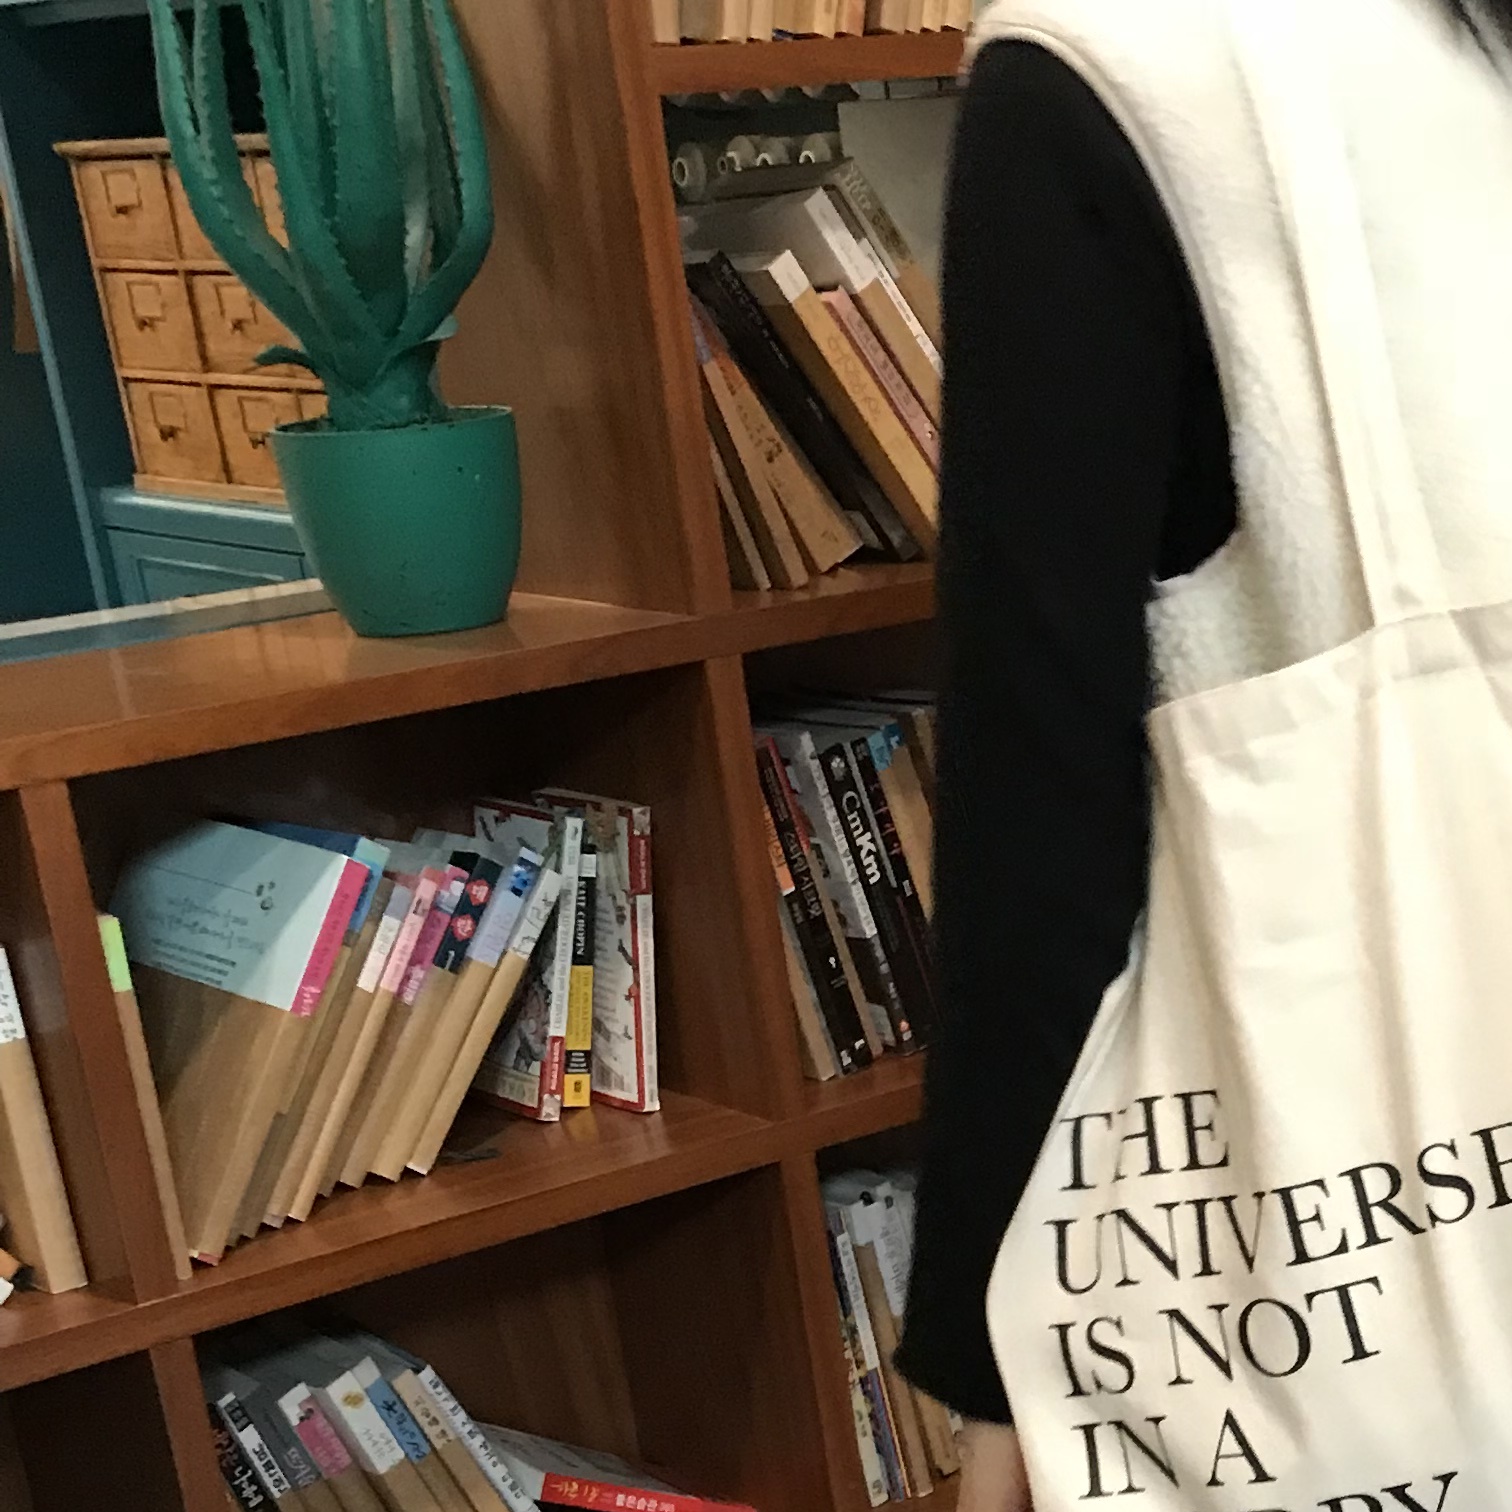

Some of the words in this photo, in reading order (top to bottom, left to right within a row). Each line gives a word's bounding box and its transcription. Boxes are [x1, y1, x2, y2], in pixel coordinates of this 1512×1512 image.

[842, 790, 881, 885] CmKm
[1058, 1089, 1231, 1192] THE
[1048, 1315, 1136, 1398] IS
[1158, 1276, 1385, 1387] NOT
[1071, 1415, 1180, 1501] IN
[1206, 1408, 1277, 1488] A
